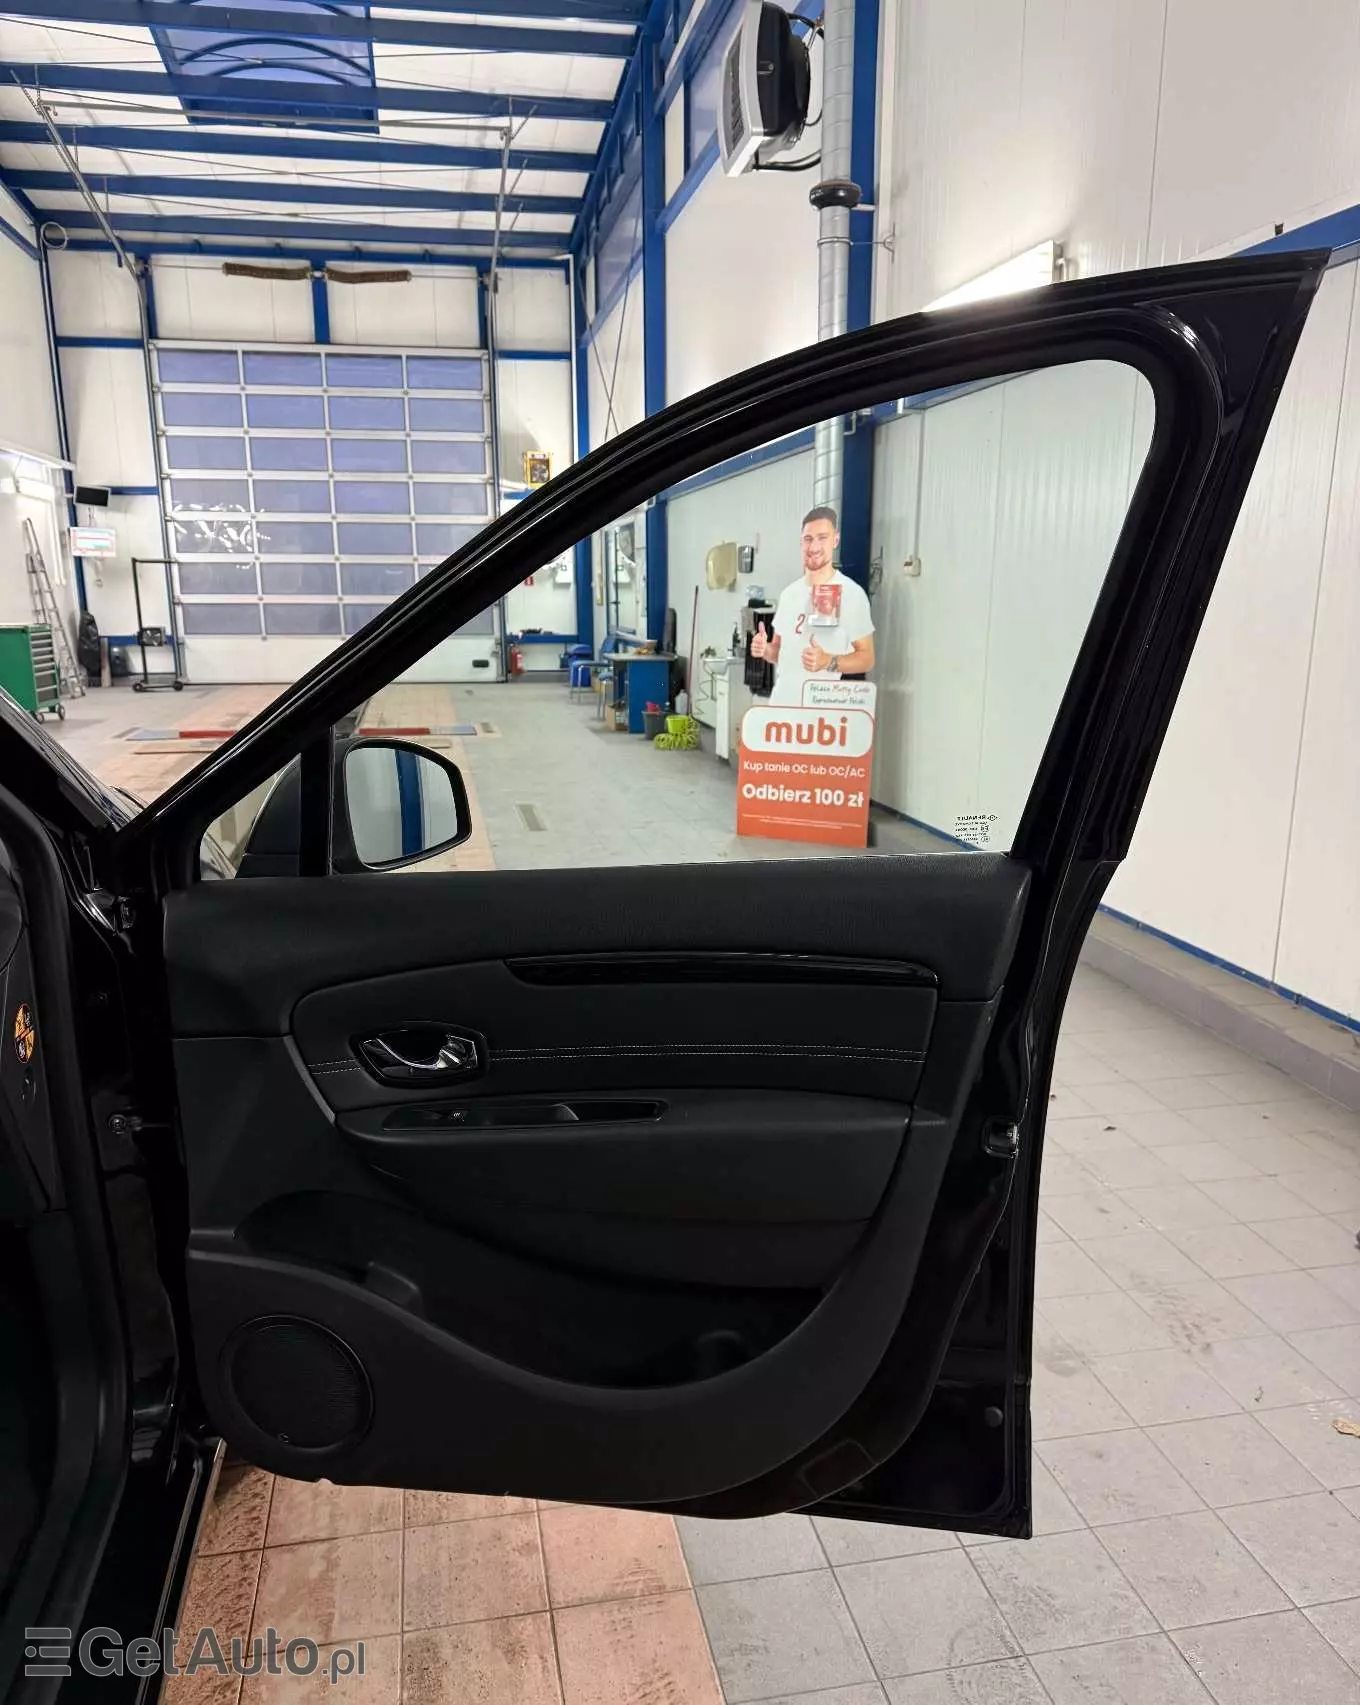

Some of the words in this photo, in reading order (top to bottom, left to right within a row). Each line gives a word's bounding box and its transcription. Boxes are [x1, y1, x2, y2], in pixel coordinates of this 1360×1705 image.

[795, 613, 806, 635] 2
[764, 716, 848, 747] mubi
[743, 760, 763, 773] Kup
[764, 762, 790, 773] tanie
[792, 763, 808, 774] OC
[810, 764, 827, 775] lub
[828, 764, 866, 779] OC/AC
[742, 783, 811, 804] Odbierz
[814, 787, 845, 806] 100
[847, 791, 865, 808] zł
